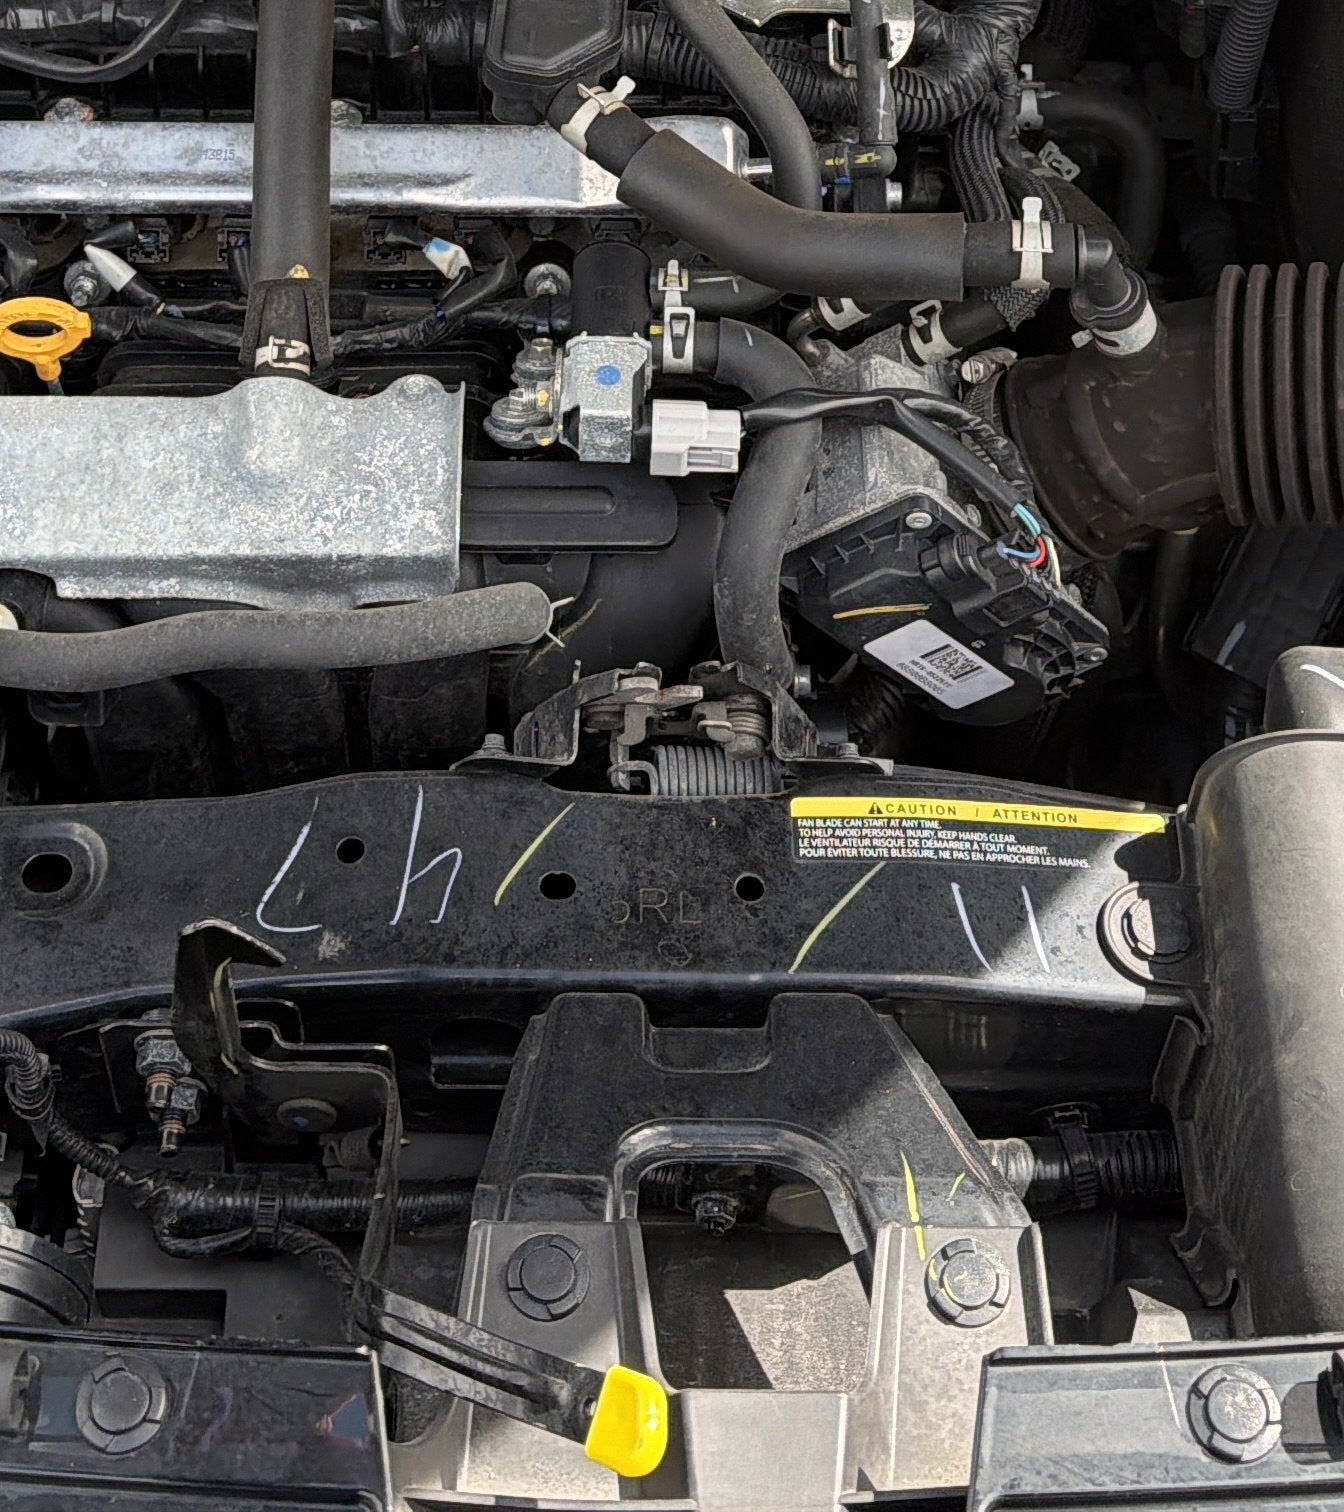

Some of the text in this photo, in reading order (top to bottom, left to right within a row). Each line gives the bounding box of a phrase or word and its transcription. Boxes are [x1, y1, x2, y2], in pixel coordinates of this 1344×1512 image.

[885, 803, 957, 817] CAUTION
[992, 808, 1079, 824] ATTENTION
[797, 818, 943, 830] FAN BLADE CAN START AT ANY TIME.
[798, 828, 811, 838] TO
[811, 828, 833, 838] HELP
[834, 828, 861, 838] AVOID
[861, 828, 905, 838] PERSONAL
[937, 831, 957, 841] KEEP
[958, 831, 989, 842] HANDS
[989, 833, 1018, 844] CLEAR.
[798, 838, 810, 847] LE
[810, 838, 872, 848] VENTILATEUR
[872, 838, 906, 849] RISQUE
[907, 838, 921, 848] DE
[921, 837, 971, 850] DÉMARRER
[981, 842, 1005, 853] TOUT
[1006, 844, 1051, 856] MOMENT.
[799, 846, 1091, 869] POUR ÉVITER TOUTE BLESSURE, NE PAS EN APPROCHER LES MAINS.
